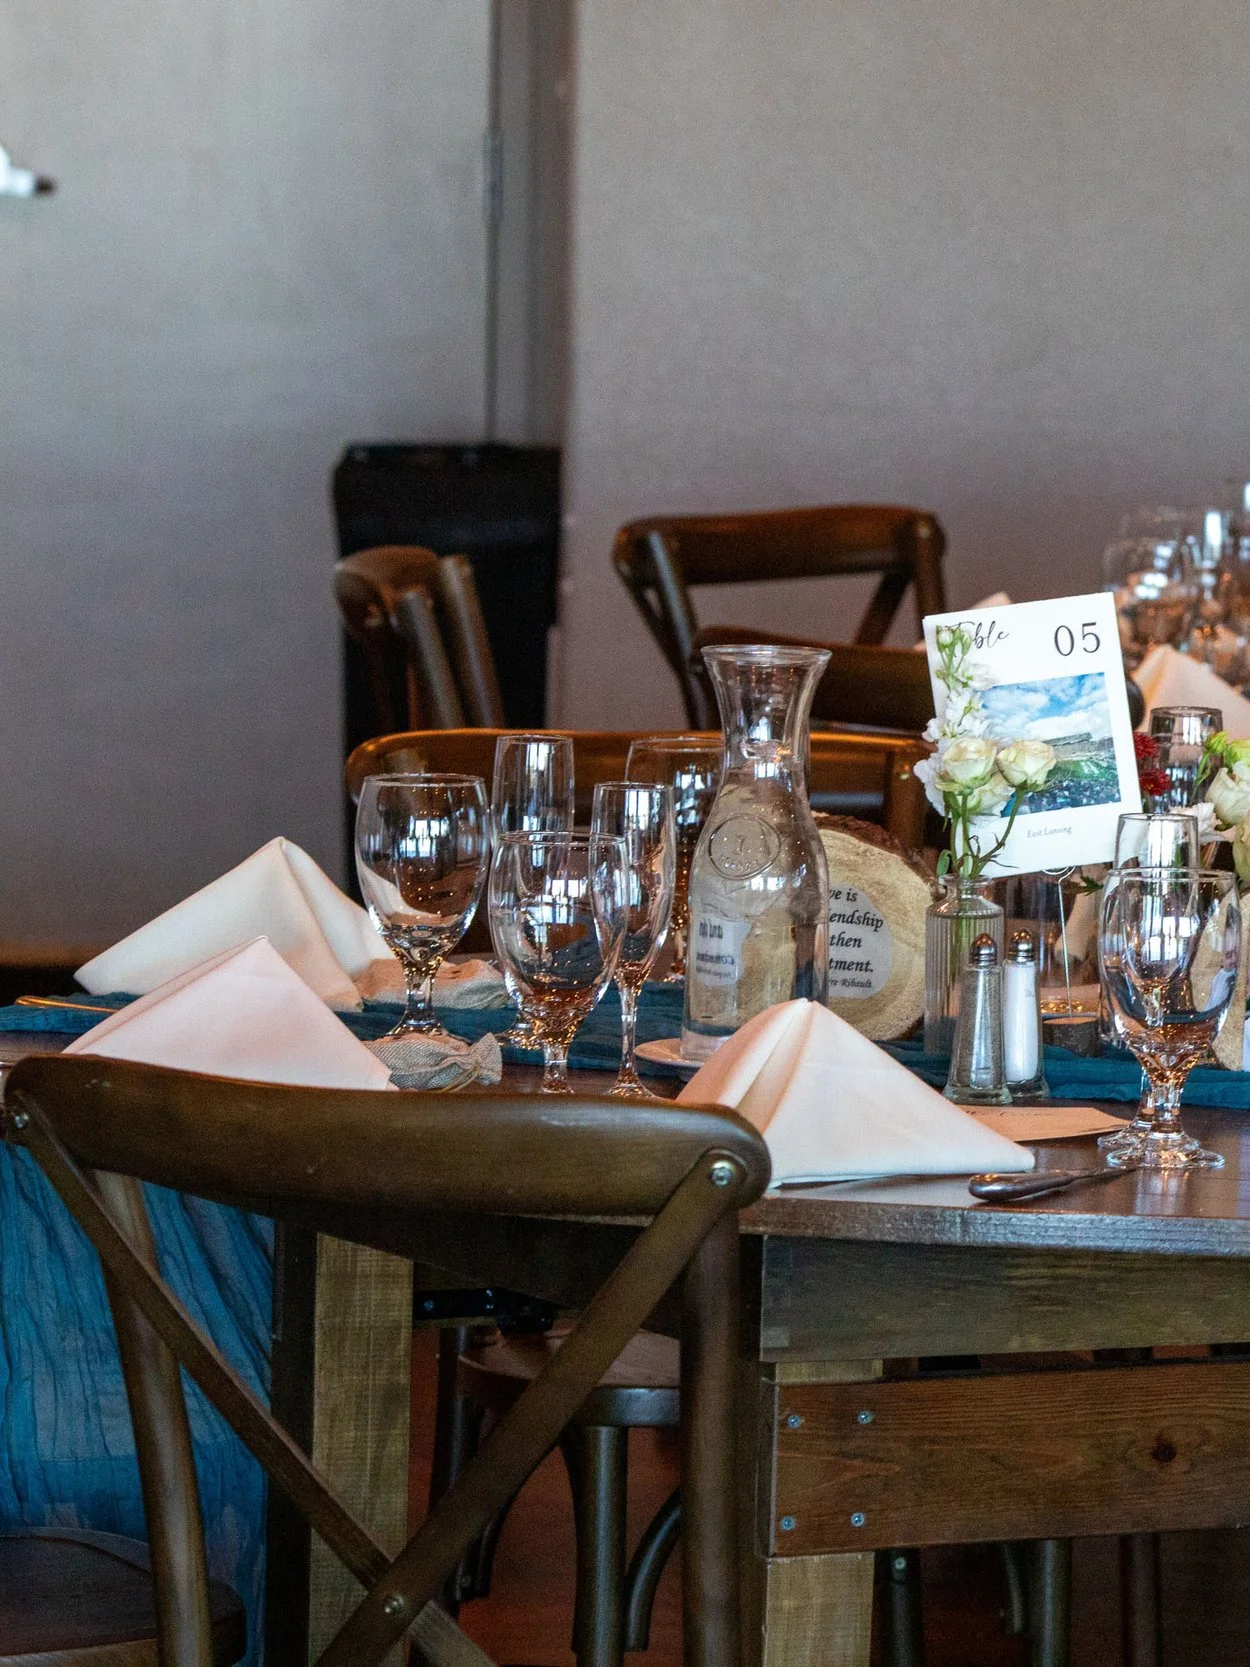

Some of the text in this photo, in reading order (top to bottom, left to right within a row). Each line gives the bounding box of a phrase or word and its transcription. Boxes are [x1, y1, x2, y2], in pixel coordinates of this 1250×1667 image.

[1053, 621, 1101, 657] 05
[829, 888, 858, 901] ve is
[829, 909, 884, 932] endship
[829, 931, 862, 948] then
[829, 957, 874, 973] tment.
